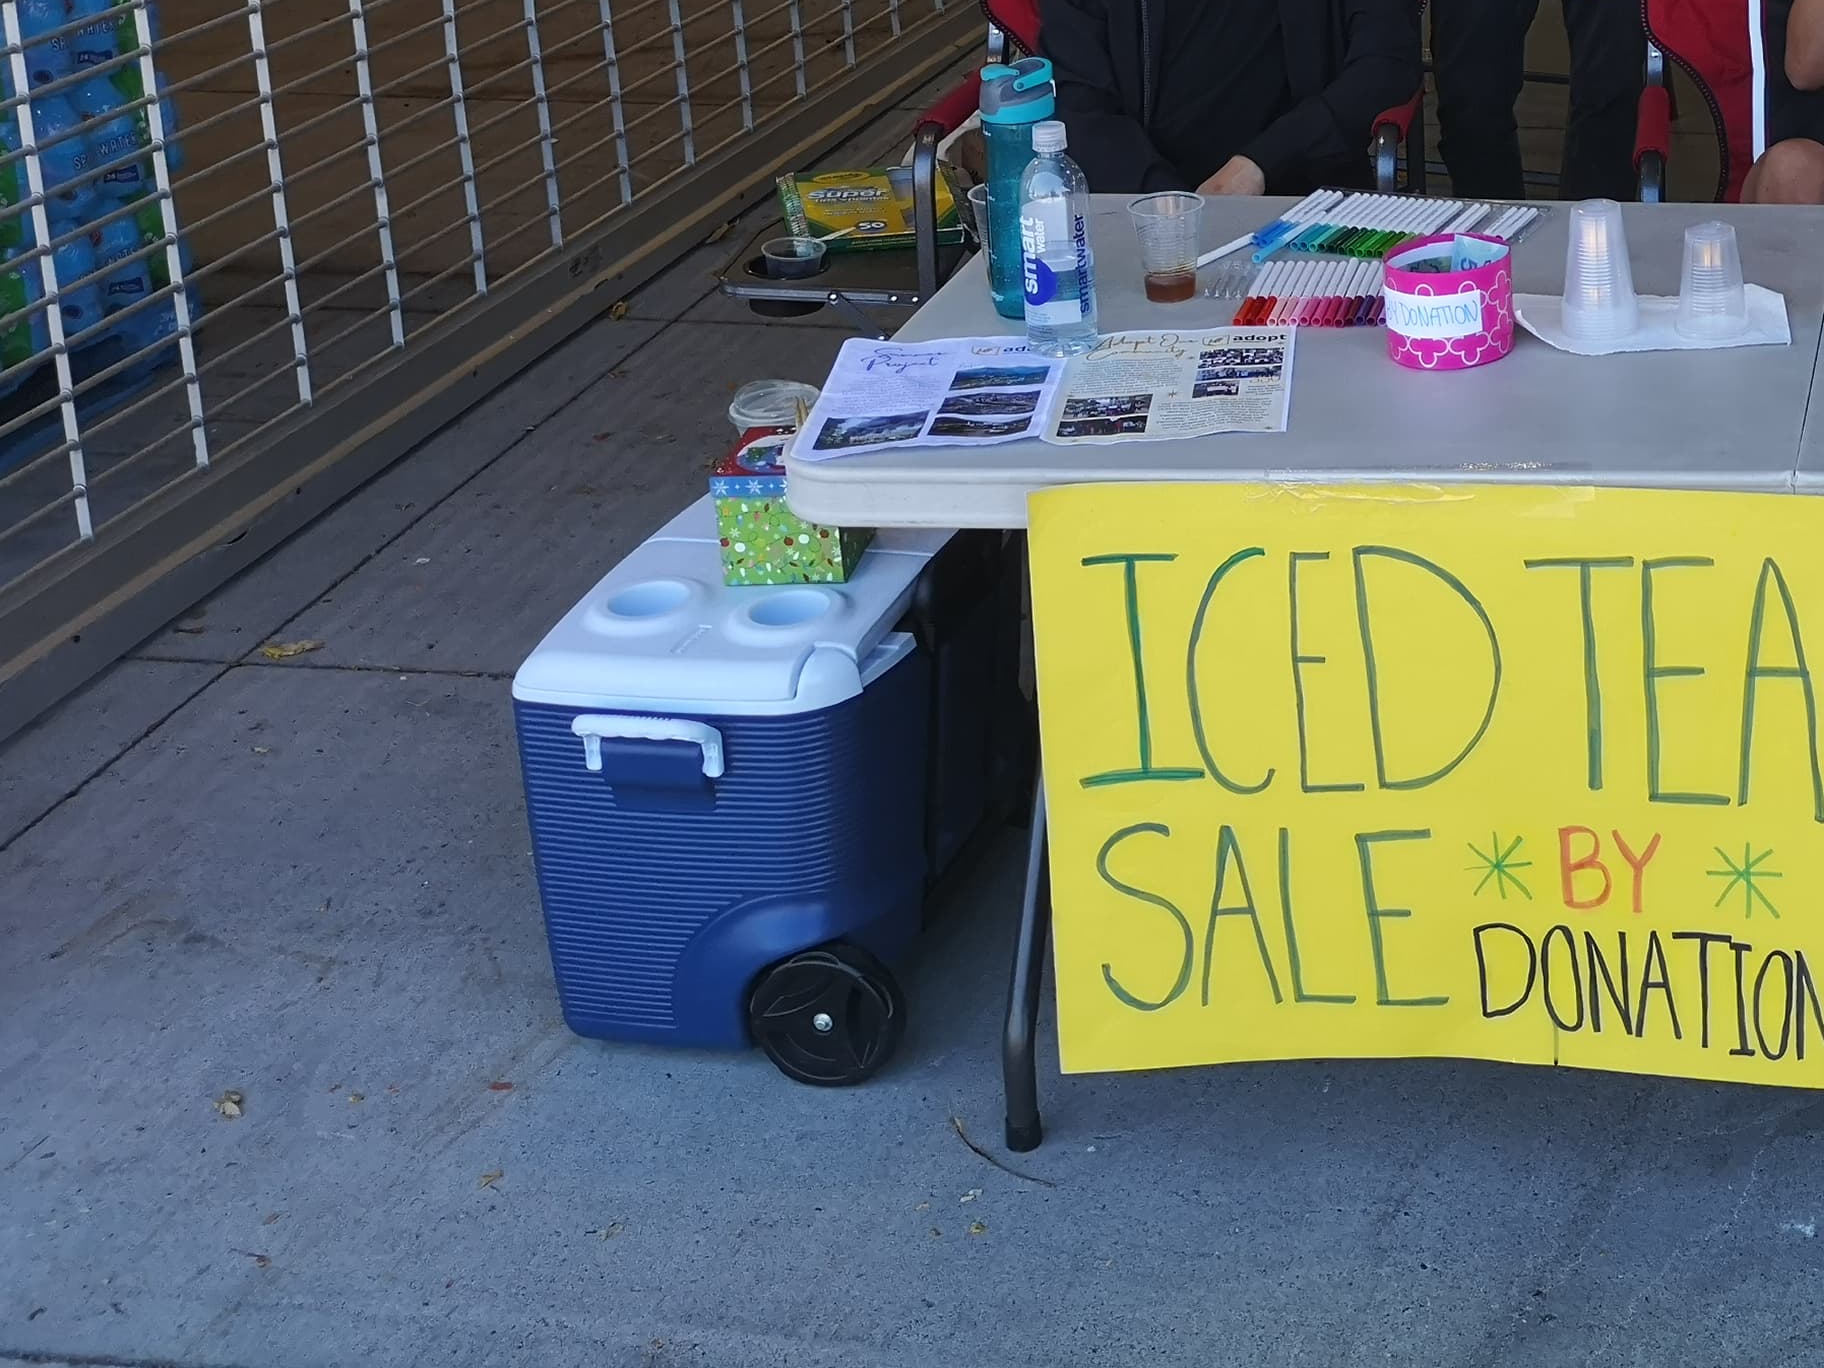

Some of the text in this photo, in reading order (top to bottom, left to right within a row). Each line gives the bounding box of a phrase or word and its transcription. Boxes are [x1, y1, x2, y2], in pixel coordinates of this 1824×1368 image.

[858, 221, 885, 231] 50
[1020, 215, 1039, 294] smart
[1034, 217, 1046, 253] water
[1073, 214, 1090, 314] smartwater
[1232, 333, 1288, 343] adopt
[1400, 299, 1480, 327] DONATION
[1080, 544, 1503, 795] ICED
[1095, 820, 1663, 1012] SALE BY
